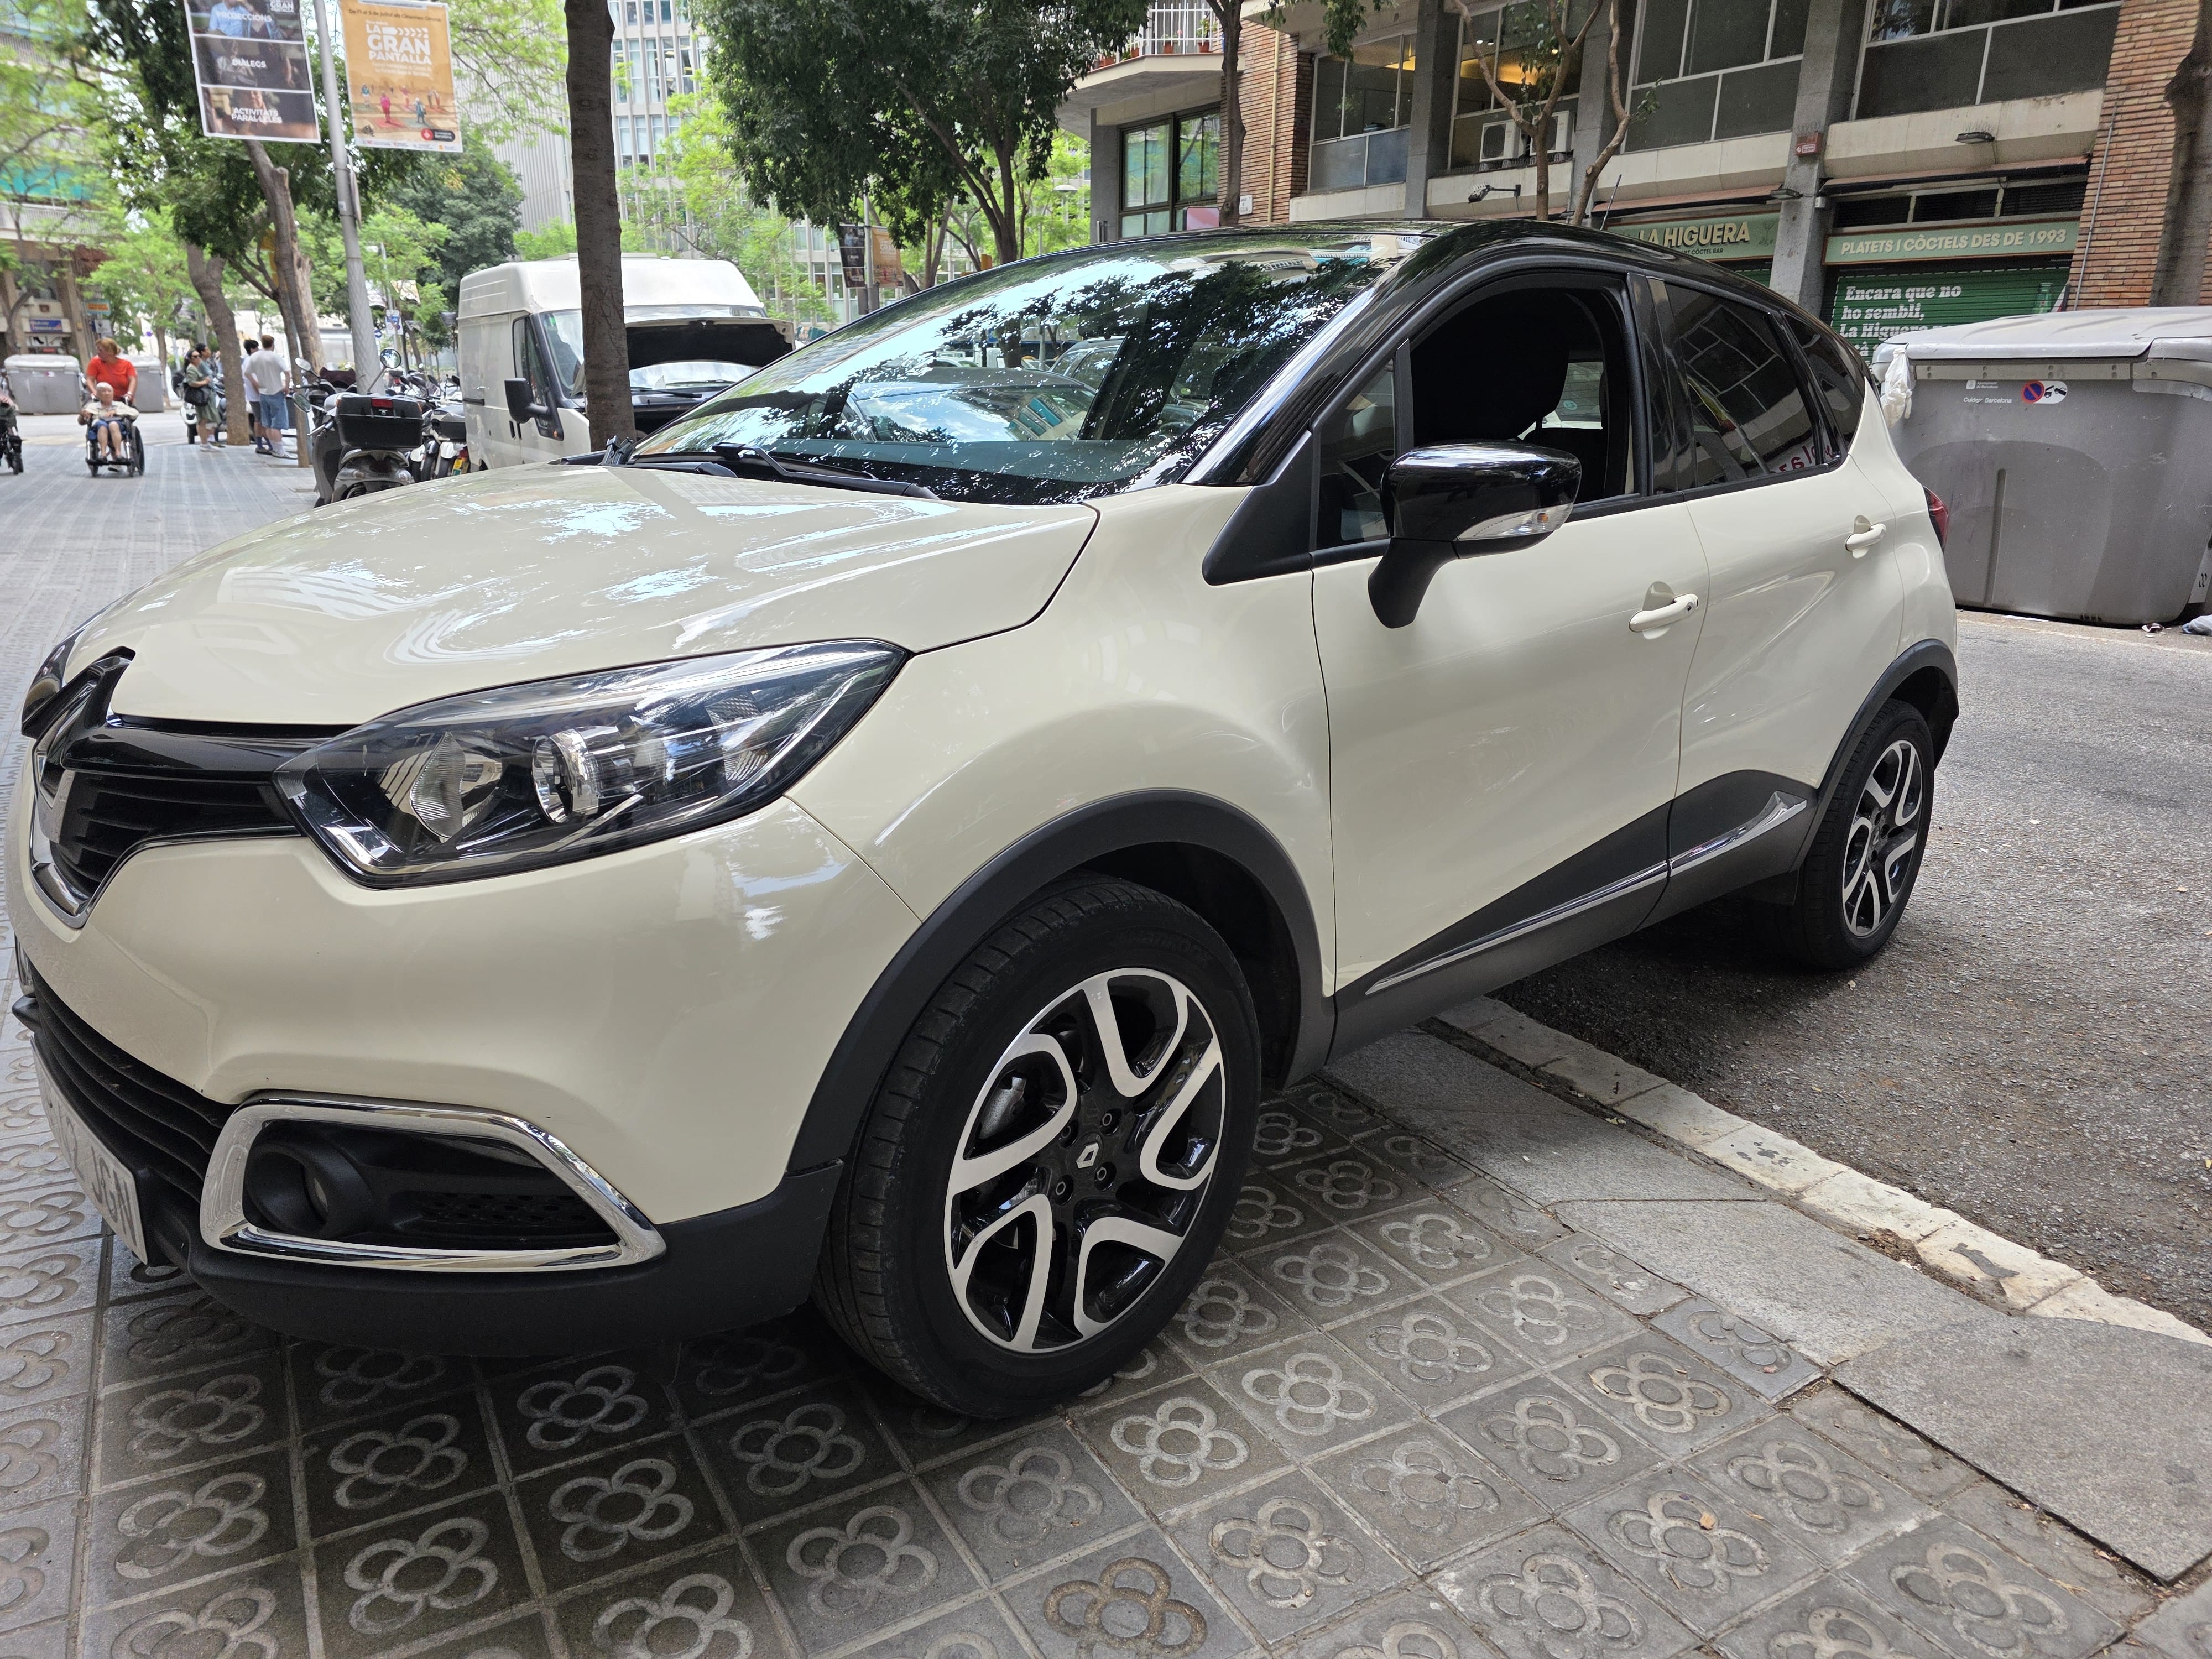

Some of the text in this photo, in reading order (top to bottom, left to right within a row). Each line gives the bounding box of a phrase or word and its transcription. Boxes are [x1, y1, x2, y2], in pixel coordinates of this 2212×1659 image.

[366, 24, 382, 34] LA
[367, 34, 430, 55] GRAN
[369, 50, 432, 65] PANTALLA
[1663, 221, 1750, 247] HIGUERA
[1841, 229, 2067, 255] PLATETS I CÒCTELS DES DE 1993
[1844, 285, 1961, 302] Encara que no
[1841, 302, 1924, 321] ho sembli,
[1839, 324, 1858, 338] La
[90, 1145, 138, 1248] JGN
